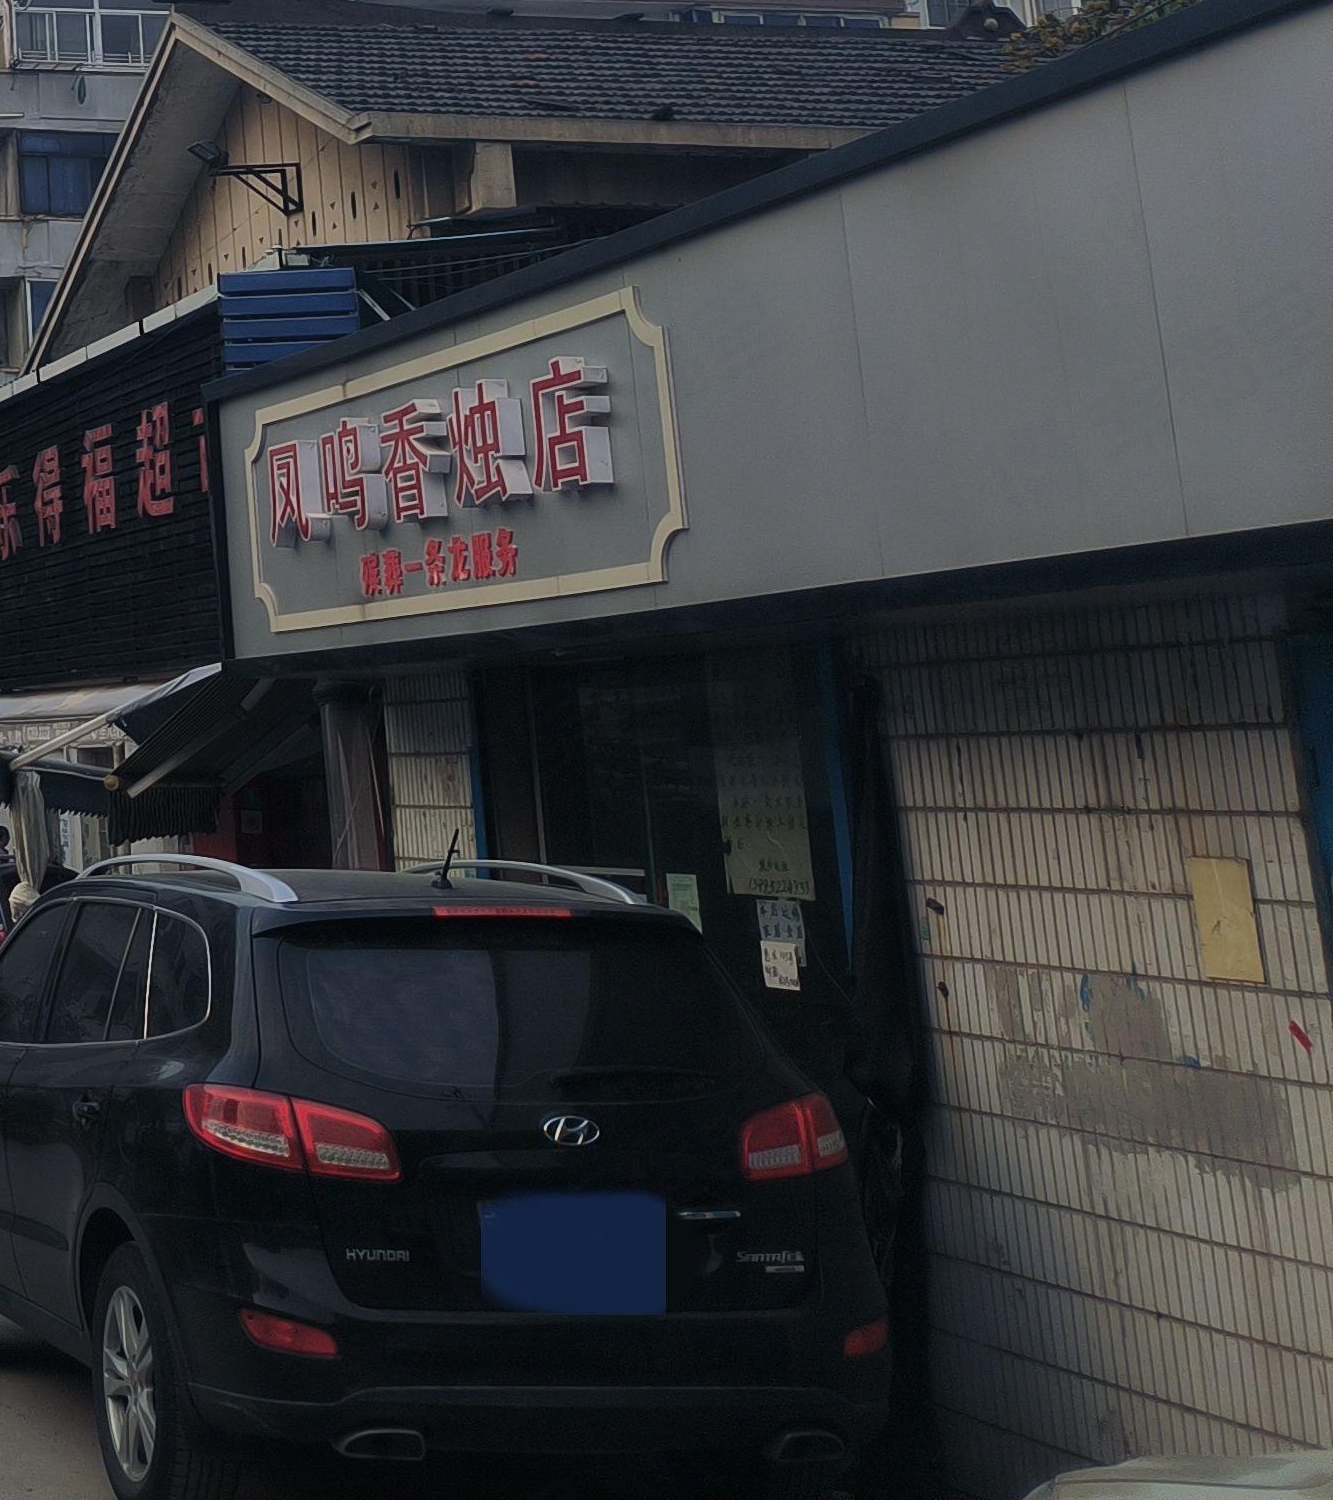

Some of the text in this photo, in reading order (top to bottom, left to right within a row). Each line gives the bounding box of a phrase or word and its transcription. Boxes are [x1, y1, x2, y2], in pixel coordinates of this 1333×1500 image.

[267, 357, 601, 548] 凤鸣香烛店
[345, 1248, 410, 1262] HYUNDAI
